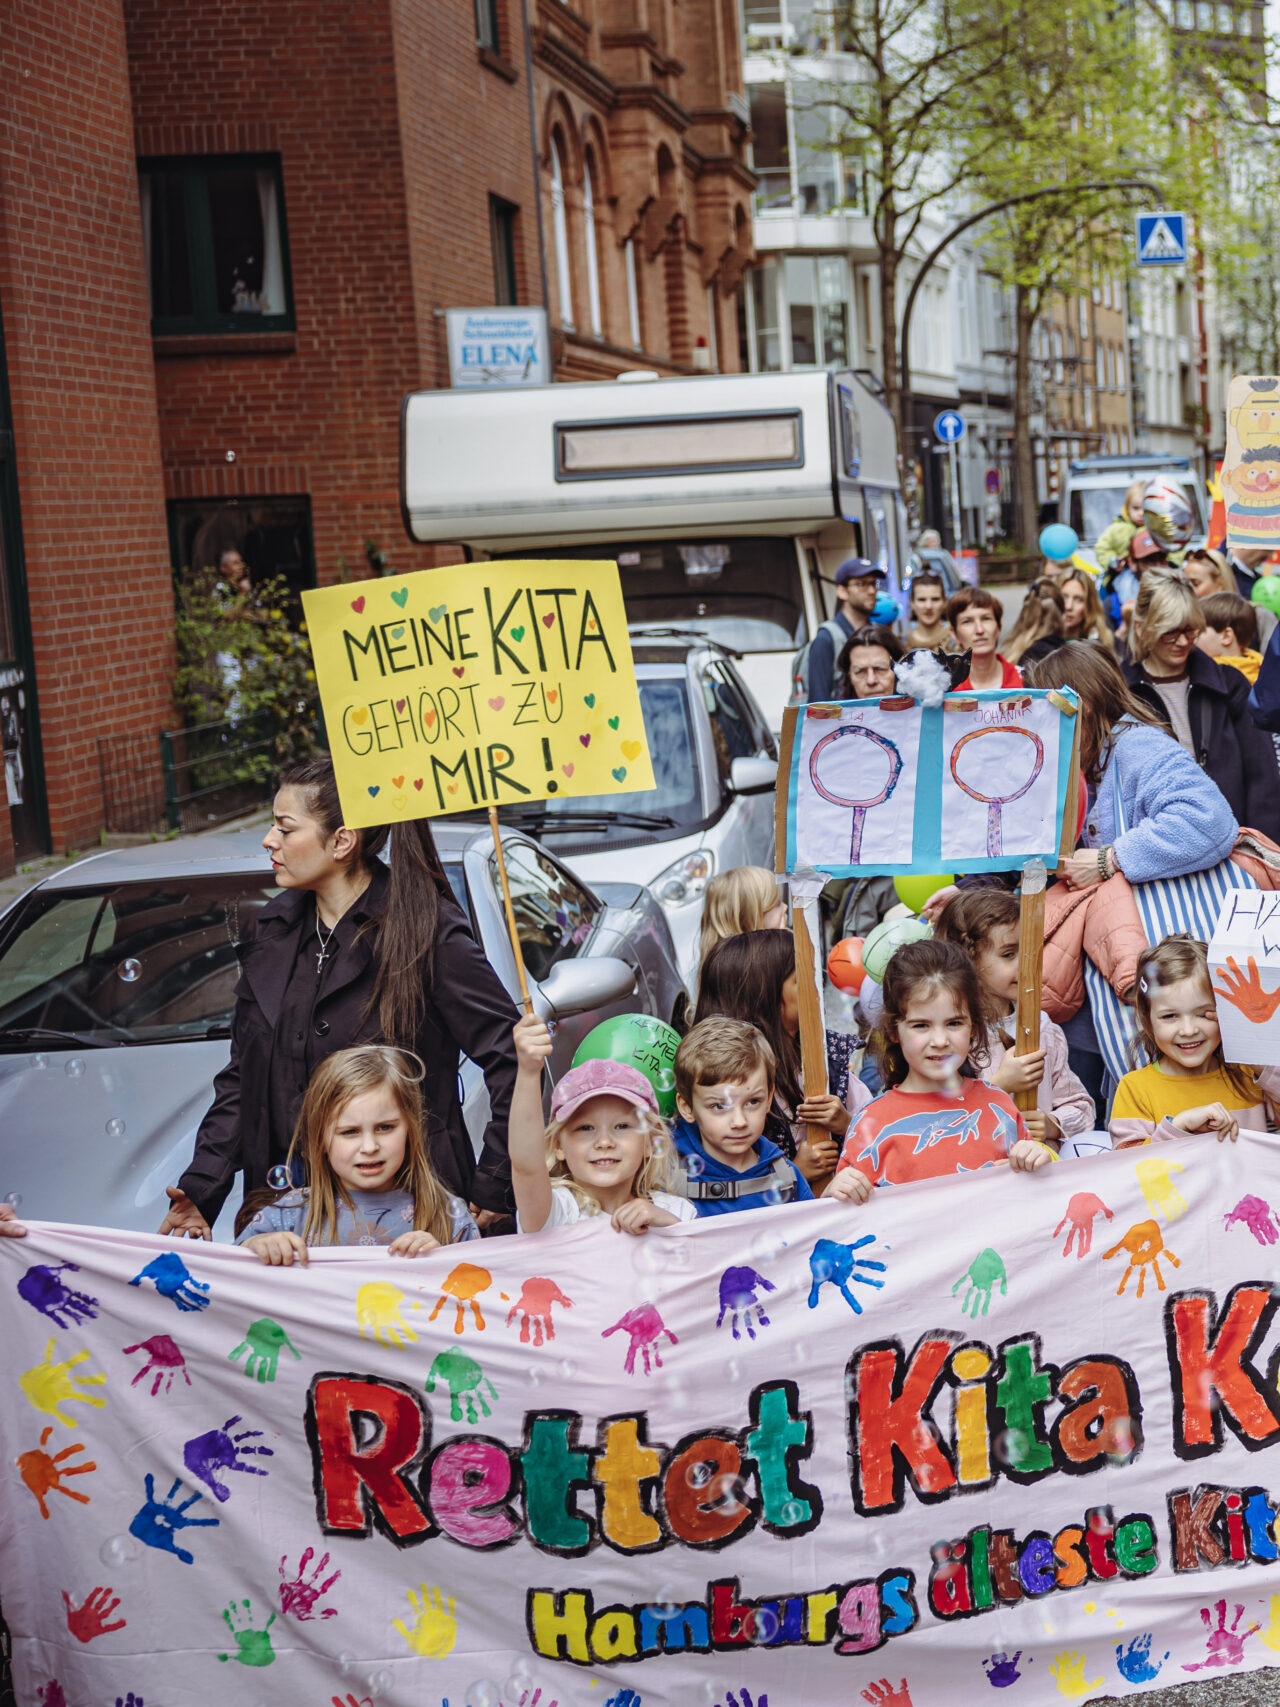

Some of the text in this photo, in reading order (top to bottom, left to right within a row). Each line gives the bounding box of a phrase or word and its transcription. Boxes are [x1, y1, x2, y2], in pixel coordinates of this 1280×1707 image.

[462, 344, 538, 366] ELENA
[343, 587, 617, 681] MEINE KITA
[343, 682, 563, 756] GEHÖRT ZU
[304, 1371, 824, 1559] Rettet
[843, 1328, 1144, 1517] Kita
[526, 1567, 920, 1666] Hamburgs
[928, 1505, 1160, 1620] älteste
